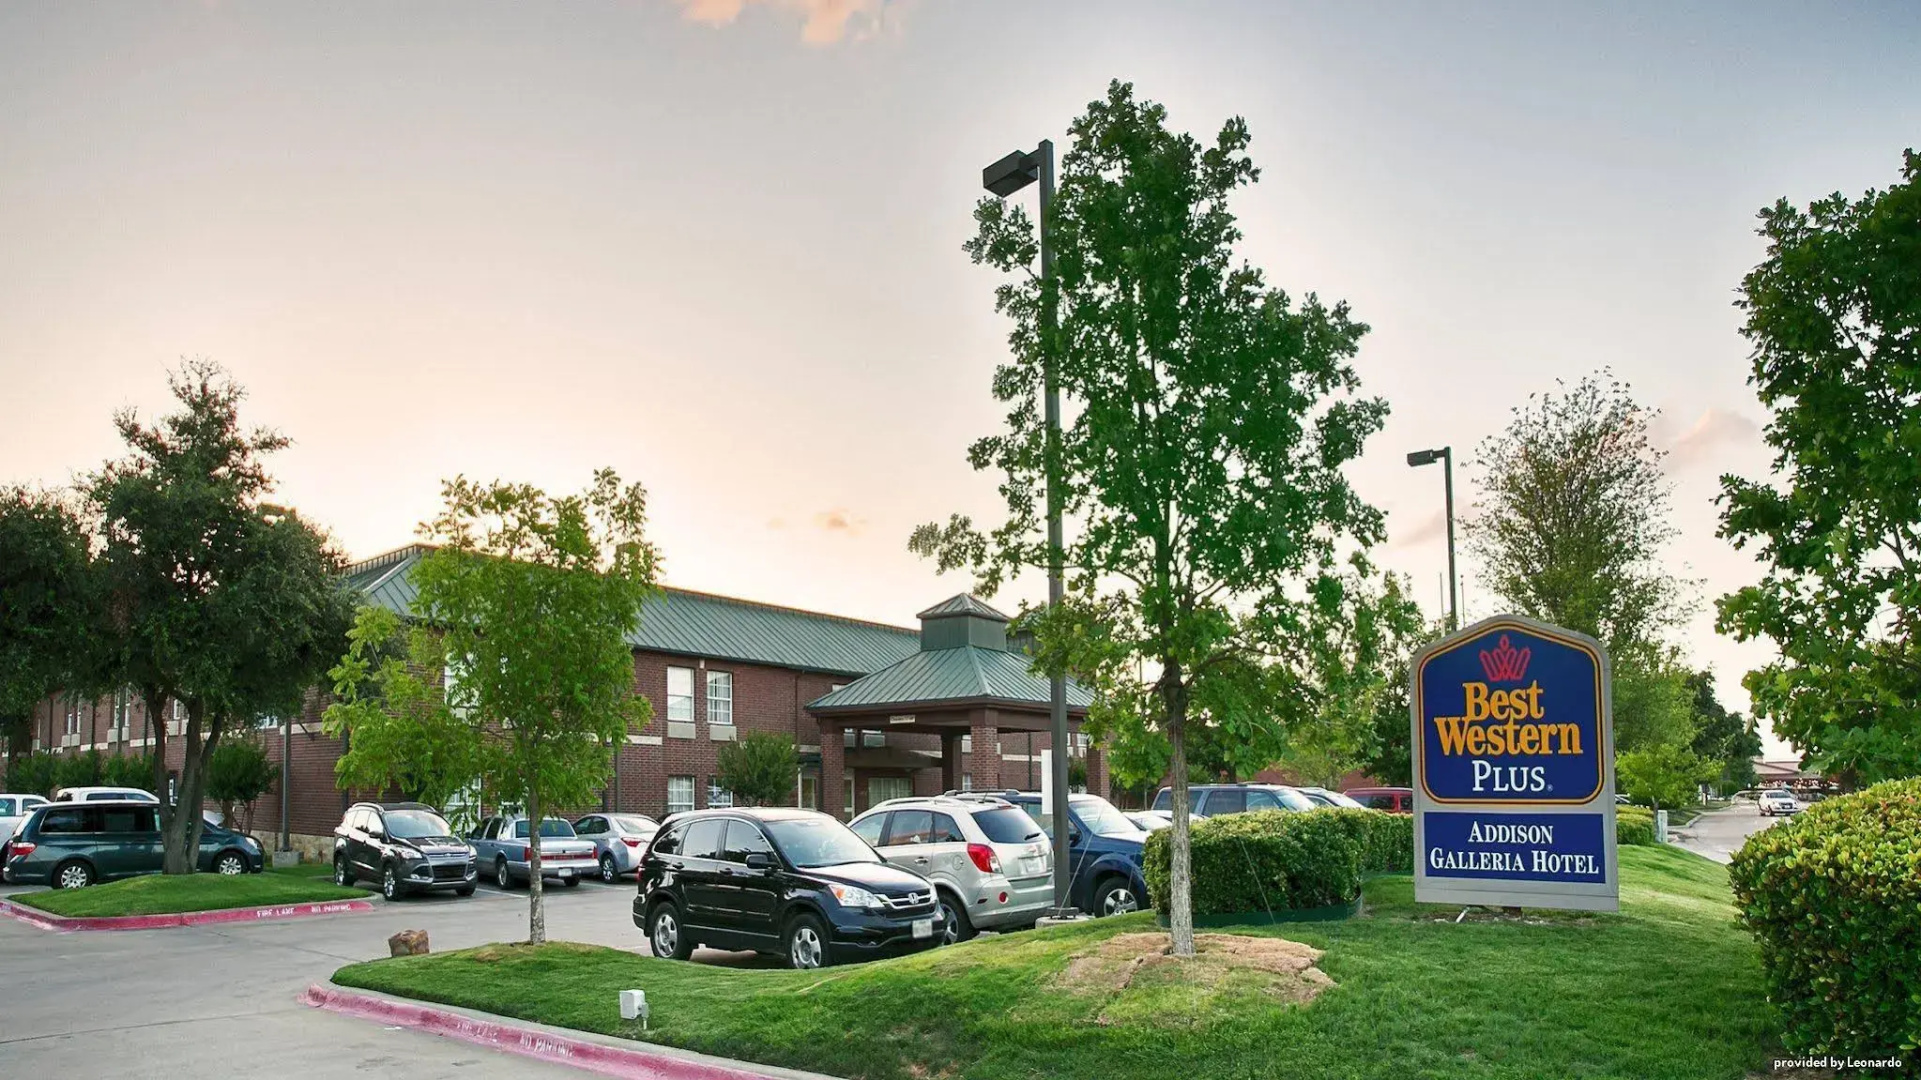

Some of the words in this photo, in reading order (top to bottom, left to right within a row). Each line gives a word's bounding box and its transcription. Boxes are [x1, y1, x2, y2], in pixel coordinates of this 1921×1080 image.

[1462, 680, 1544, 721] Best
[1434, 714, 1584, 756] Western
[1472, 760, 1546, 792] PLUS
[1468, 821, 1554, 844] ADDISON
[1430, 847, 1525, 872] GALLERIA
[1532, 851, 1599, 875] HOTEL
